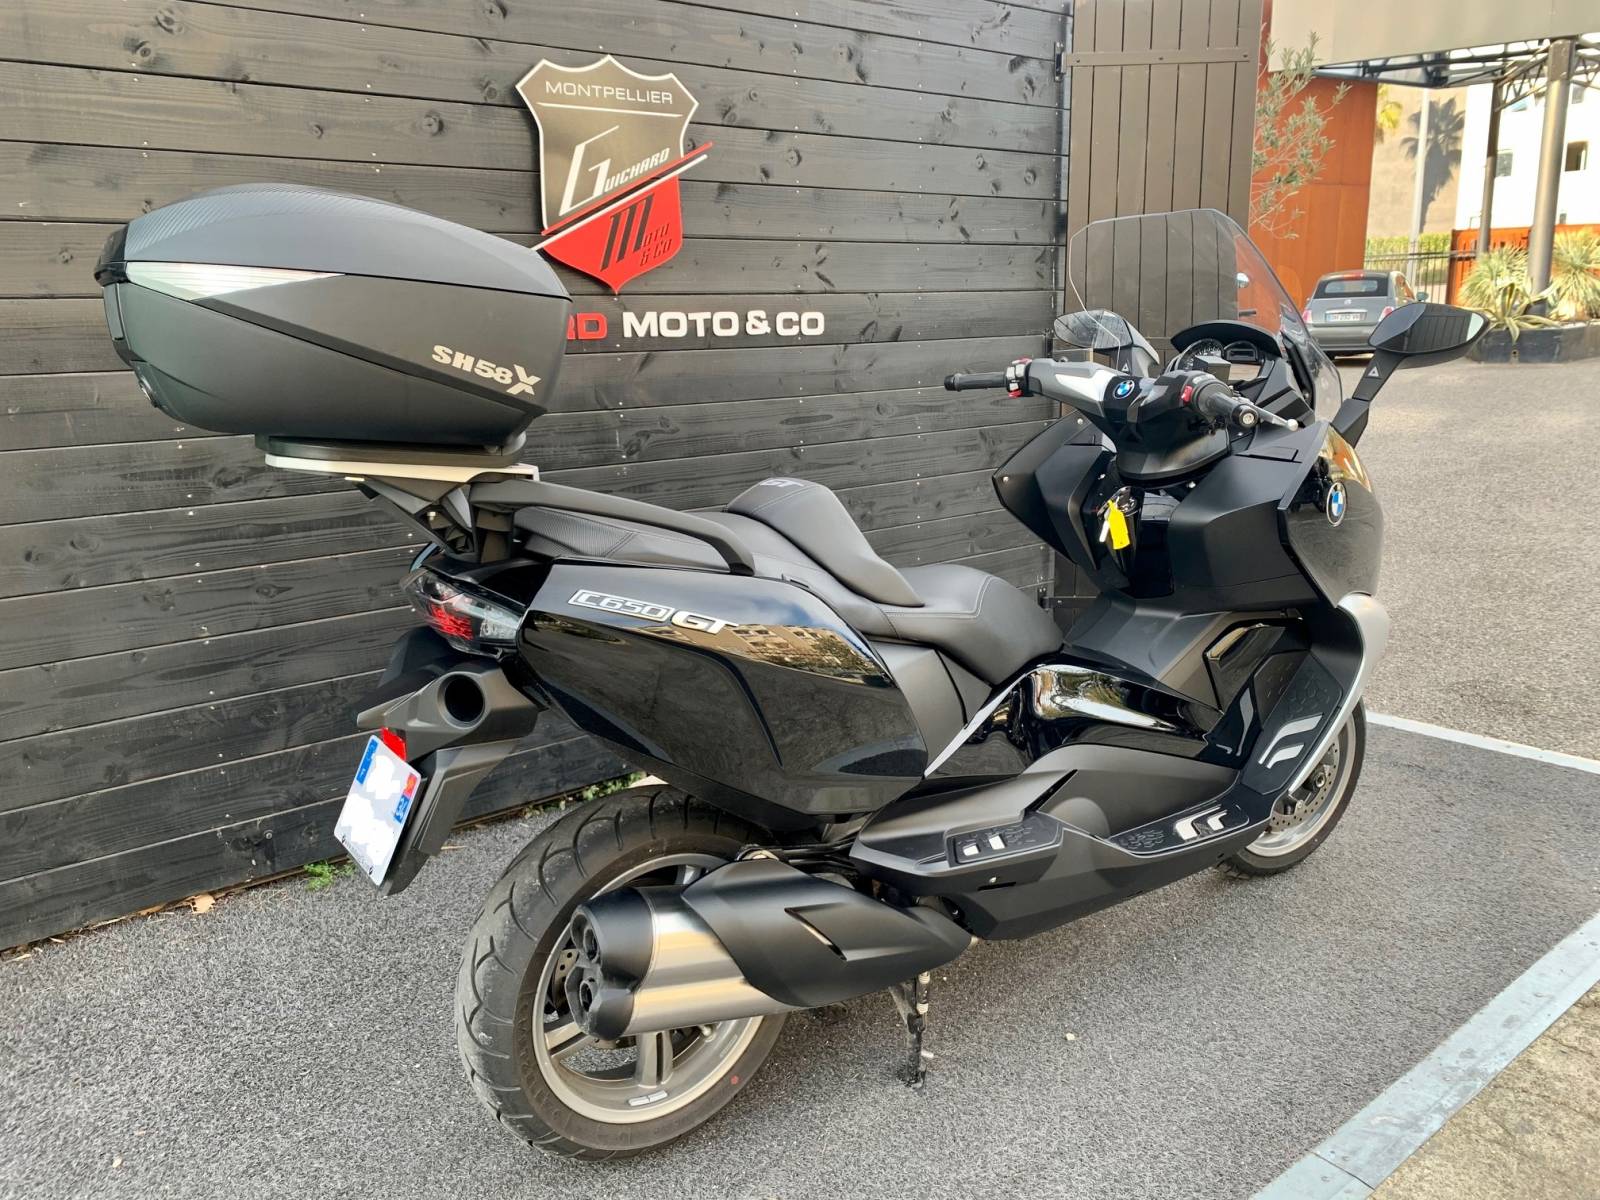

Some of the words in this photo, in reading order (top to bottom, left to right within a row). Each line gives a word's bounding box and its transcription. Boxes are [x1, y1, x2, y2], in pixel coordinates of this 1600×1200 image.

[545, 80, 673, 105] MONTPELLIER
[622, 311, 739, 337] MOTO
[746, 310, 772, 336] &
[776, 311, 825, 337] CO
